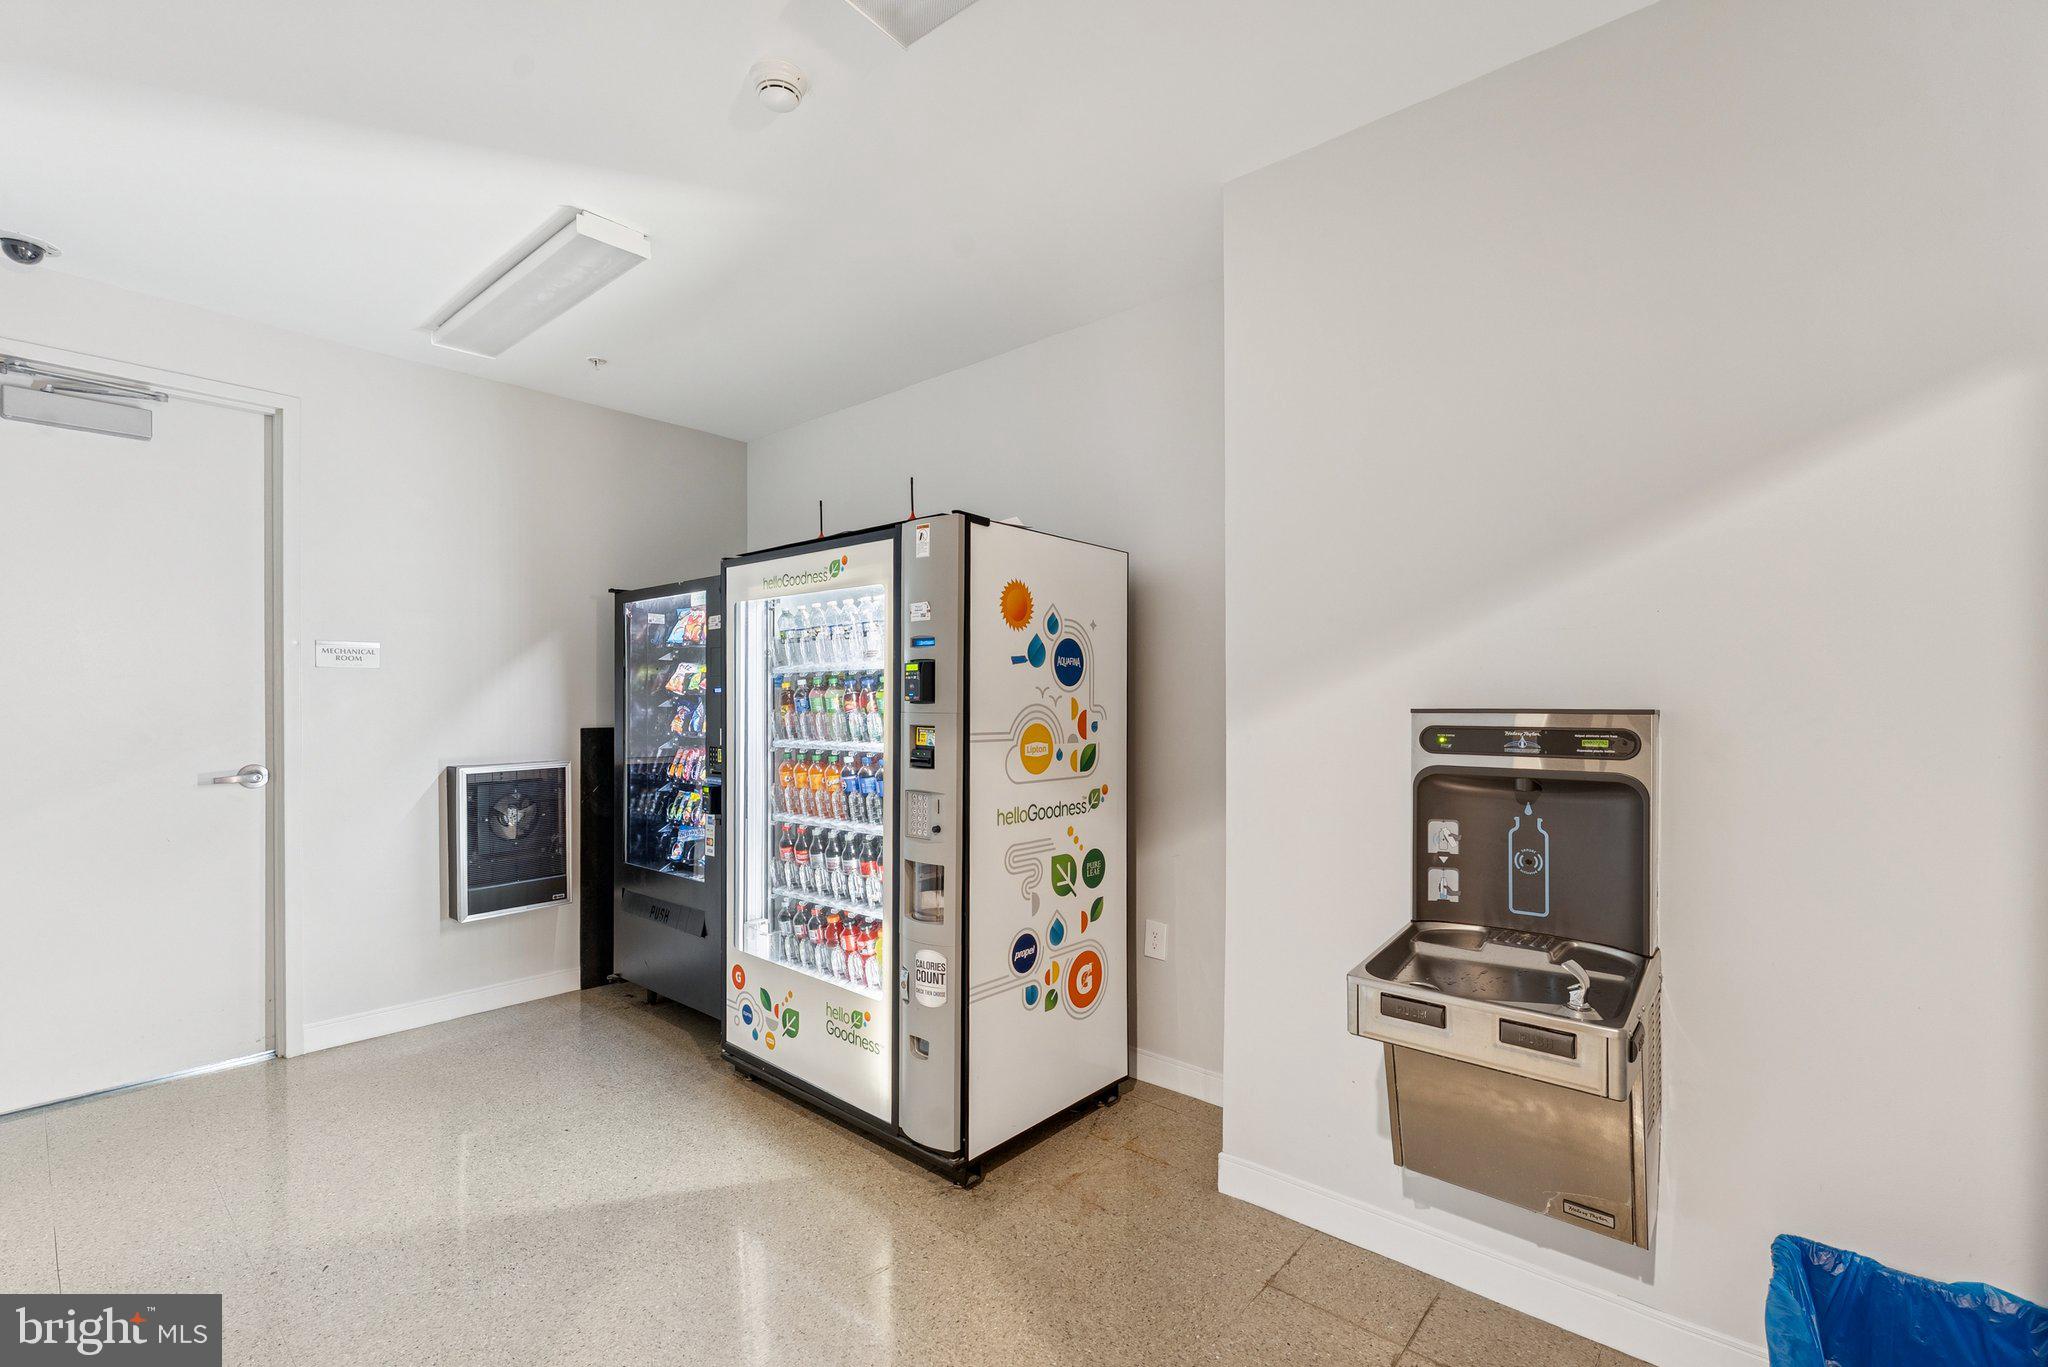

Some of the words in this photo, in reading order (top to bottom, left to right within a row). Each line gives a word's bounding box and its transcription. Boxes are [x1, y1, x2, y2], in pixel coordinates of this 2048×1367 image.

[763, 570, 828, 590] helloGoodness
[321, 647, 376, 656] MECHANICAL
[1057, 655, 1081, 668] AQUAFINA
[1026, 745, 1047, 756] Lipton
[996, 800, 1087, 827] helloGoodness
[1086, 860, 1101, 870] PURE
[1086, 867, 1101, 878] LEAF
[649, 904, 671, 924] PUSH
[1014, 944, 1036, 963] propel
[915, 959, 946, 972] CALORIES
[915, 969, 946, 985] COUNT
[1075, 962, 1093, 995] G
[825, 1001, 850, 1024] hello
[825, 1020, 880, 1055] Goodness
